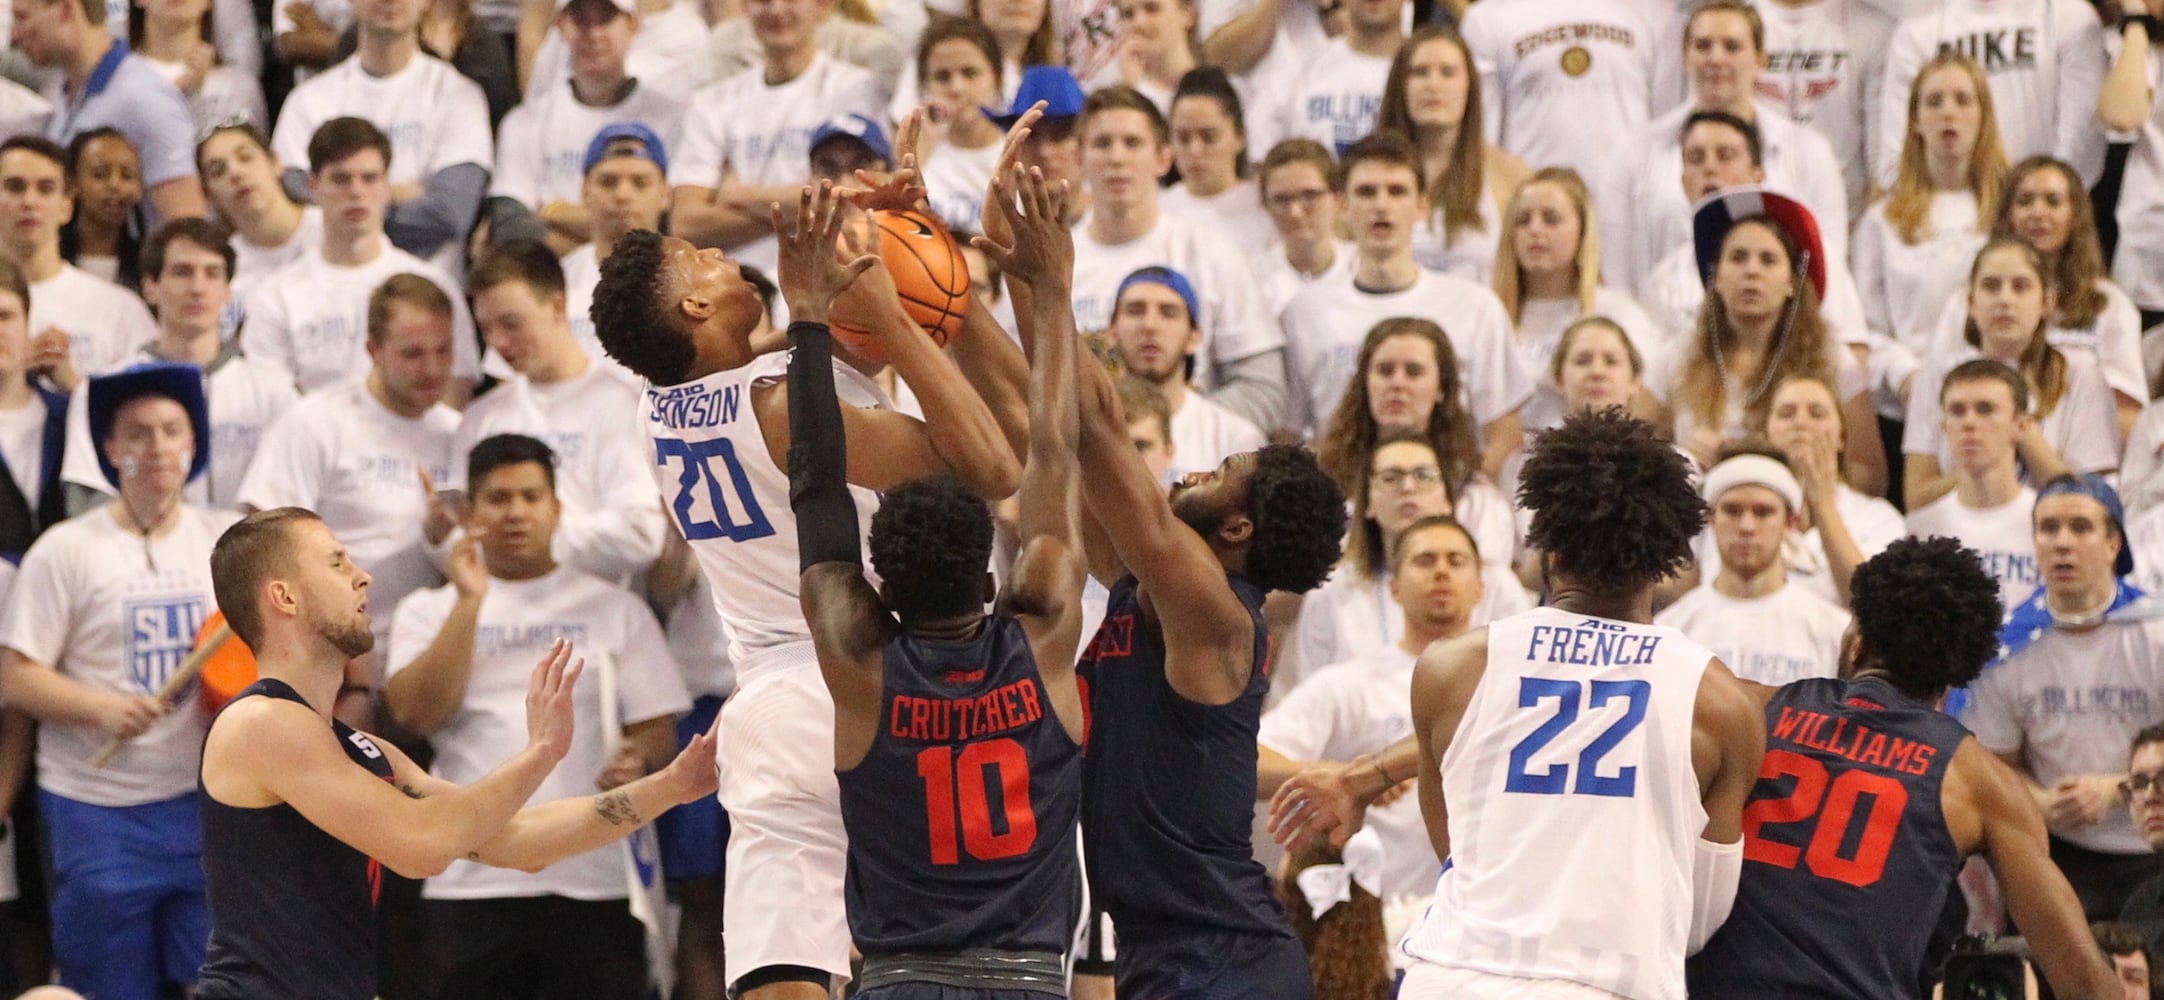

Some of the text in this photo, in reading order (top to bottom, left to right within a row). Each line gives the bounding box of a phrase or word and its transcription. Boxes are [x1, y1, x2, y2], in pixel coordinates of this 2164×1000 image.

[654, 437, 776, 543] 20
[1526, 625, 1662, 667] FRENCH
[1577, 618, 1627, 632] A10
[891, 677, 1043, 741] CRUTCHER
[1504, 676, 1652, 797] 22
[1772, 706, 1938, 776] WILLIAMS
[917, 736, 1037, 865] 10
[1743, 748, 1909, 888] 20
